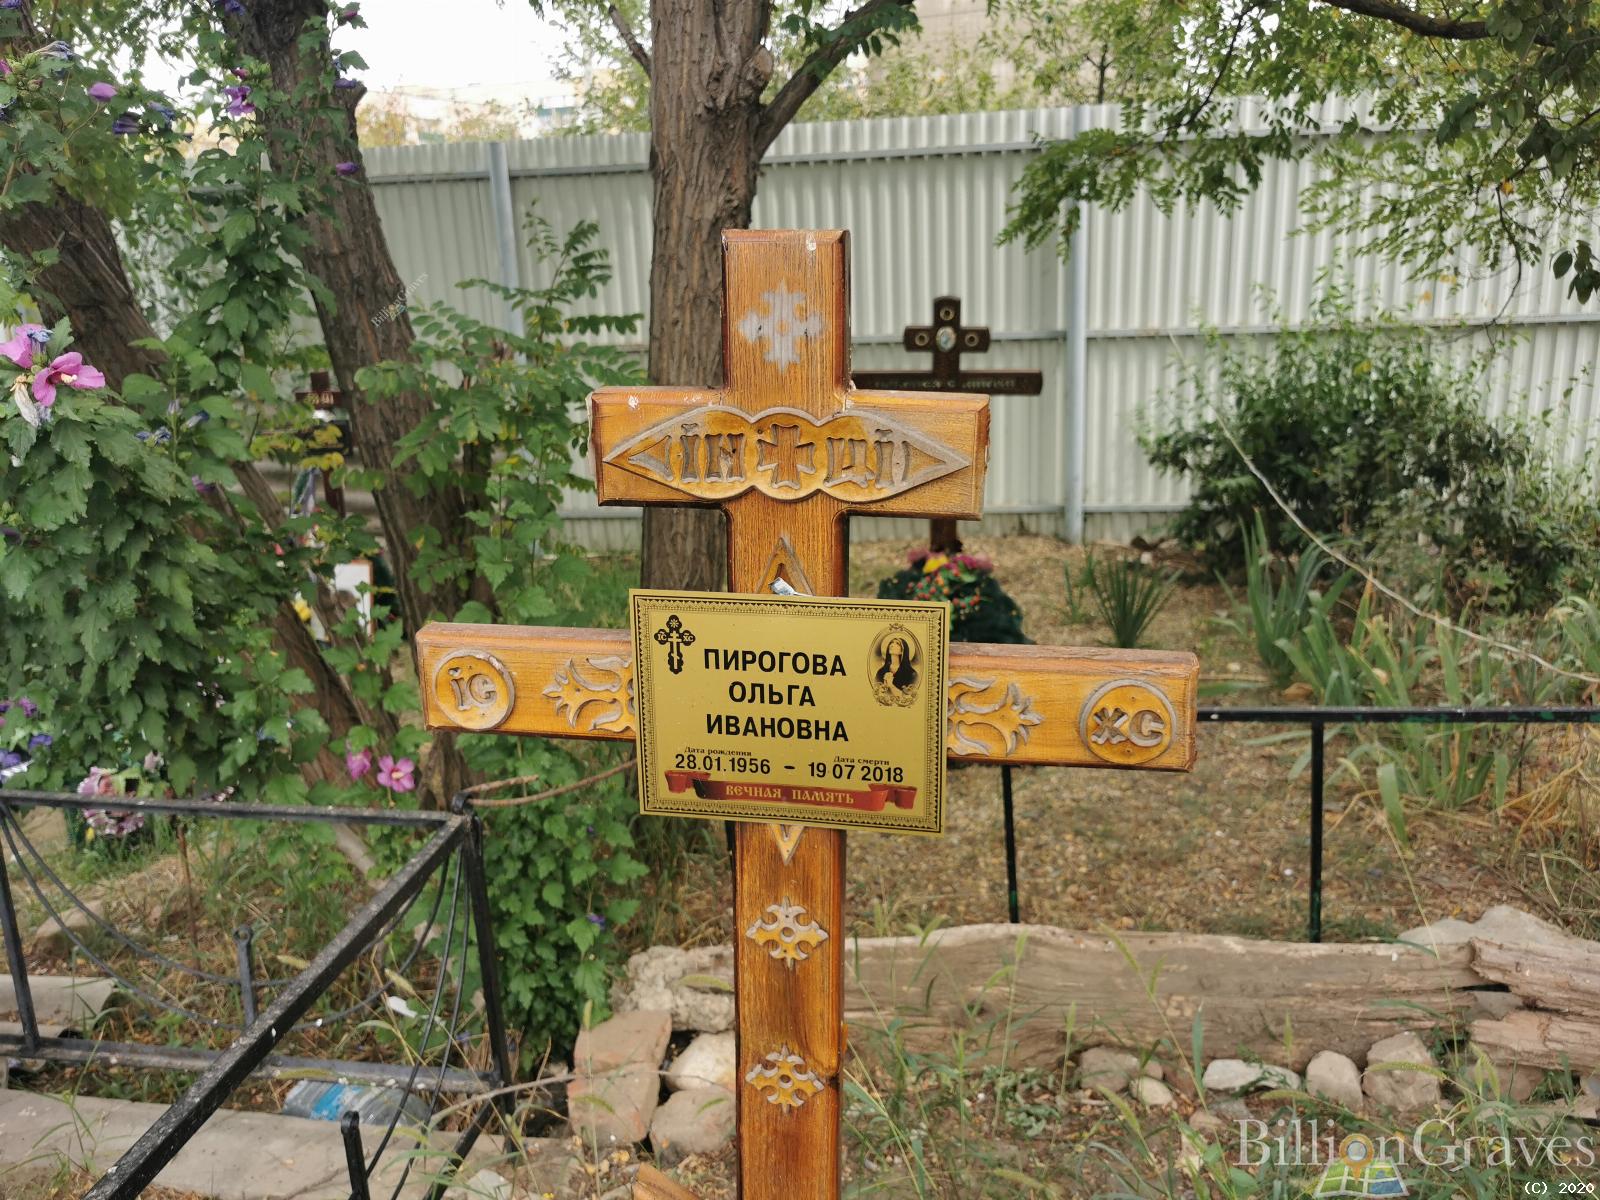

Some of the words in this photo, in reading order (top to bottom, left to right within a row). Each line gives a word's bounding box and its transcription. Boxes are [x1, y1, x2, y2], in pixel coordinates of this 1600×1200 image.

[703, 648, 847, 677] ПИРОГОВА
[728, 681, 816, 707] ОЛЬГА
[706, 713, 849, 742] ИВАНОВНА
[684, 746, 705, 754] Дата
[707, 749, 752, 757] рождения
[833, 755, 855, 763] Дата
[857, 758, 890, 766] смерти
[675, 753, 771, 775] 28.01.1956
[860, 765, 904, 783] 2018
[725, 784, 782, 799] ВЕЧНАЯ
[792, 789, 854, 804] ПАМЯТЬ
